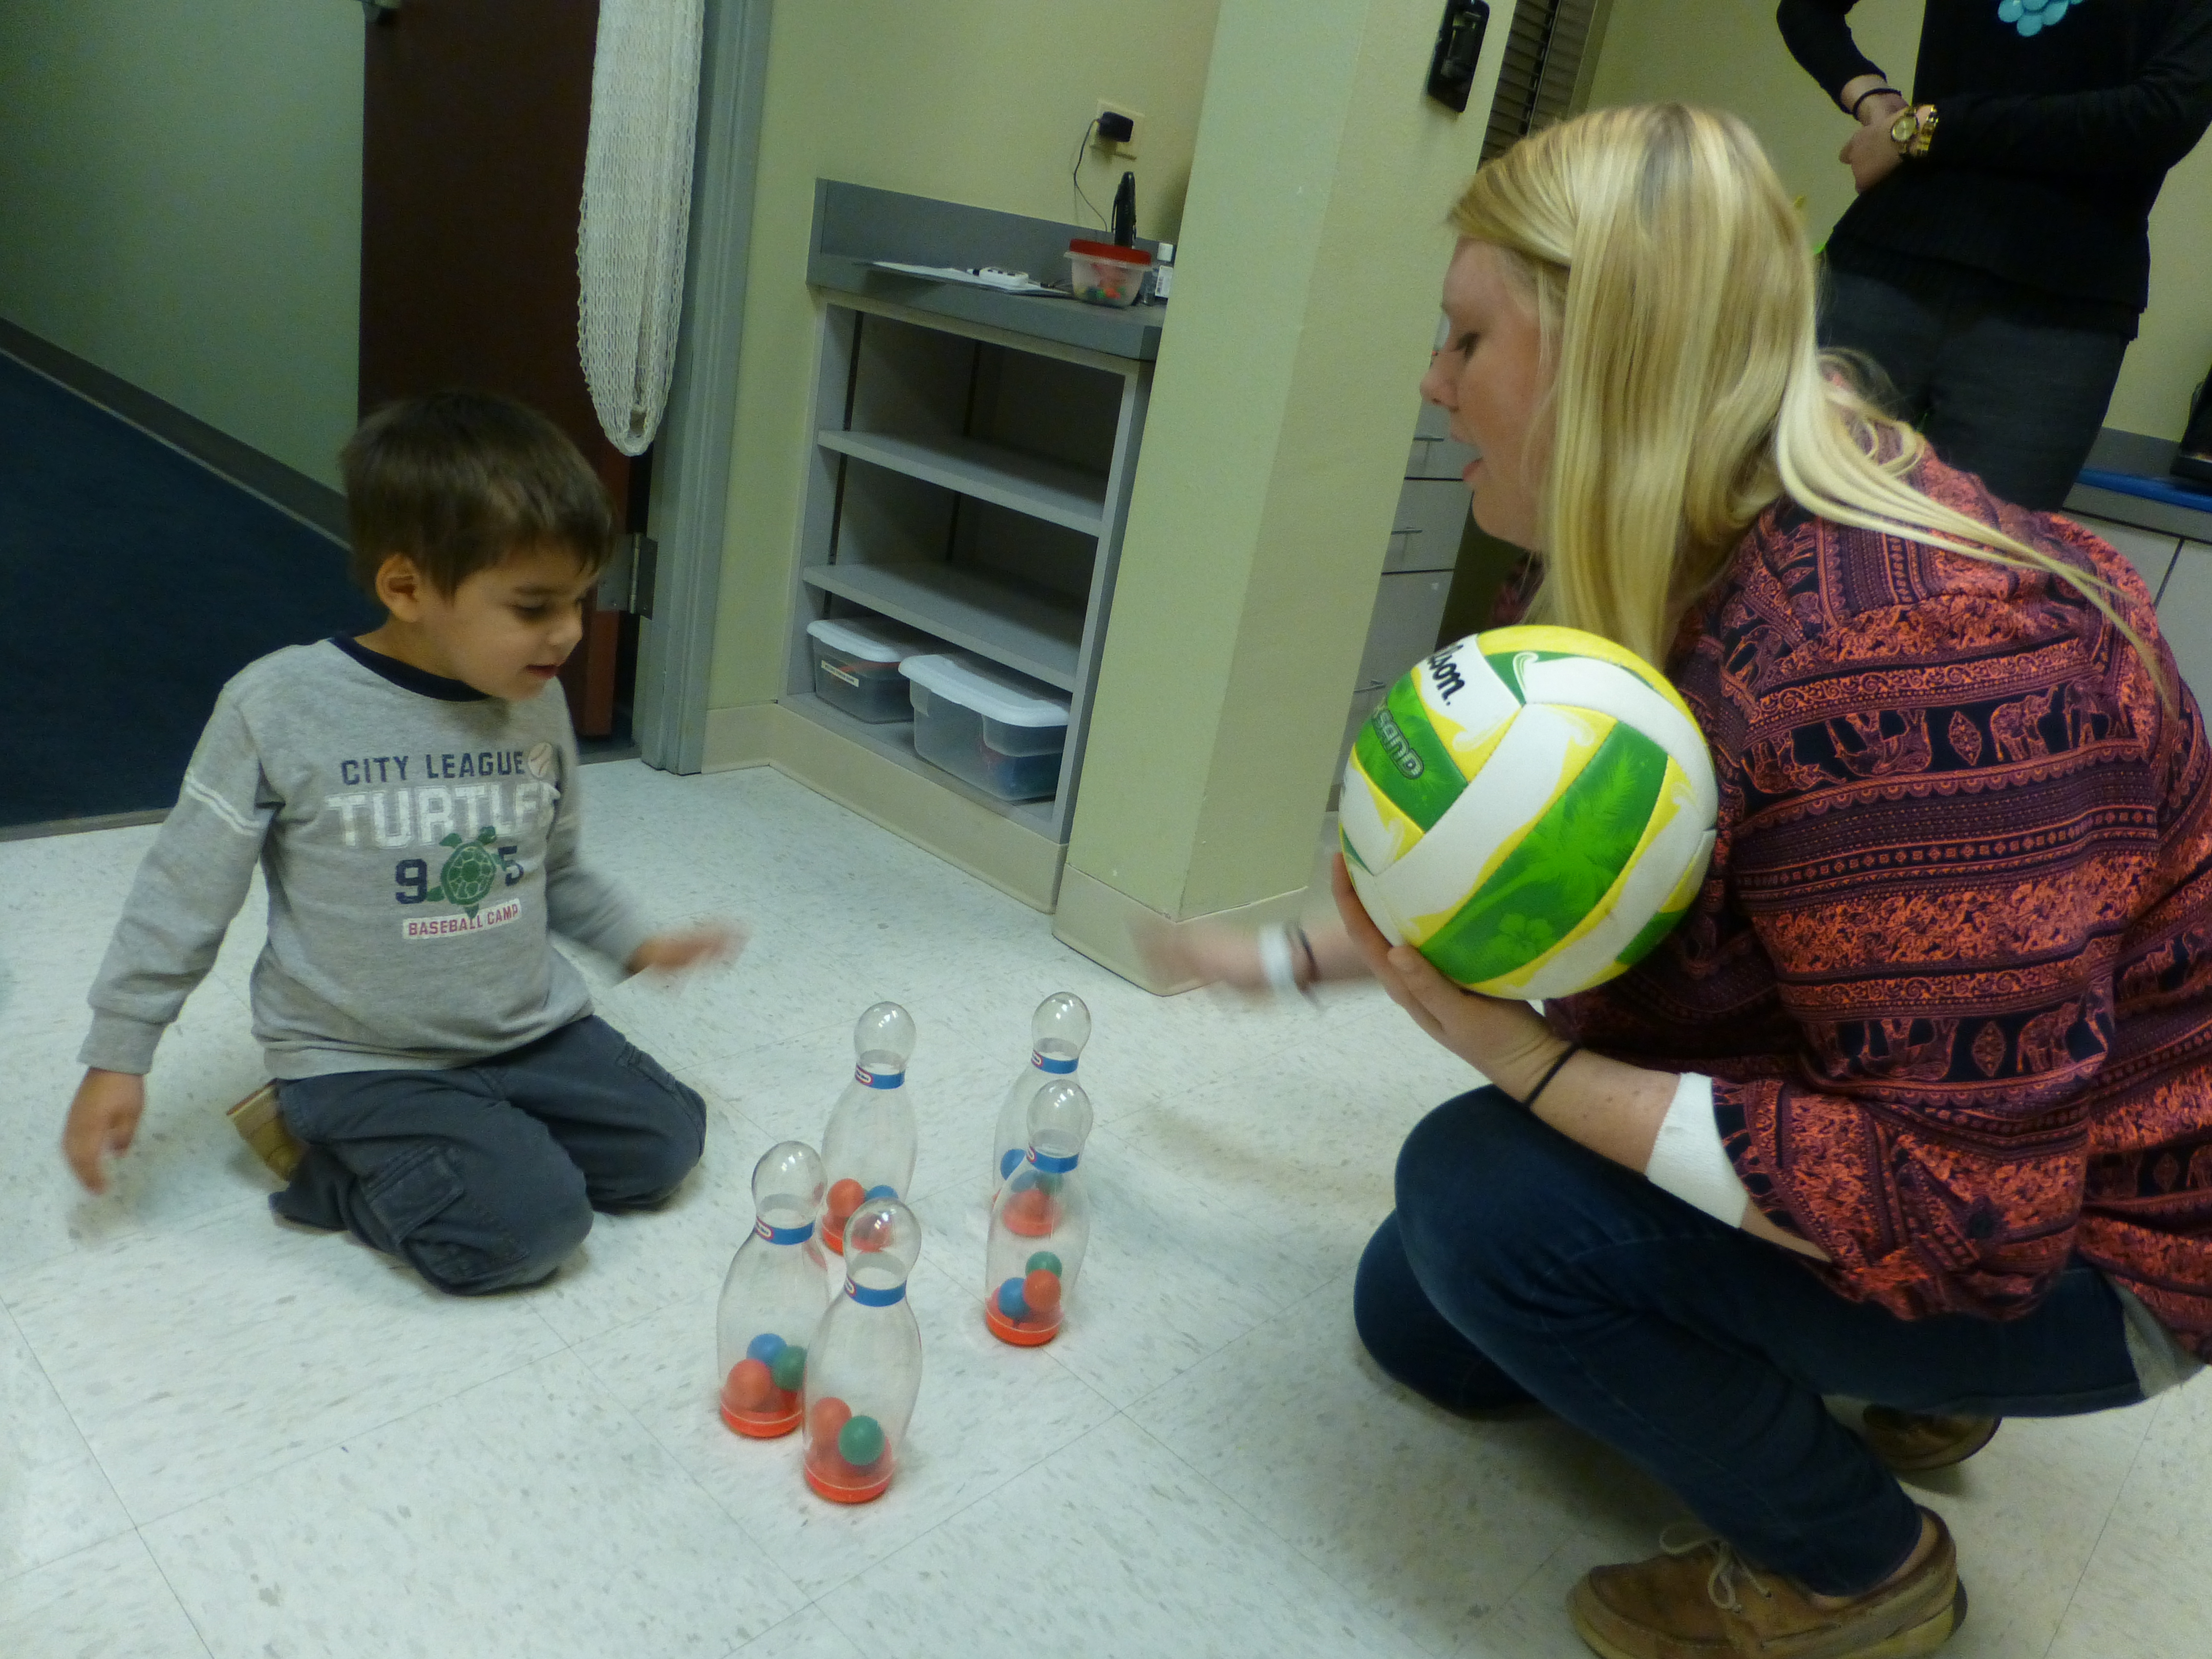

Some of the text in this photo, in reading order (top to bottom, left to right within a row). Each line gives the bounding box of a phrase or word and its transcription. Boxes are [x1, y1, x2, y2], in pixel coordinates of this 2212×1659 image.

[341, 751, 525, 785] CITY LEAGUE
[395, 858, 428, 904] 9
[408, 903, 519, 935] BASEBALL CAMP
